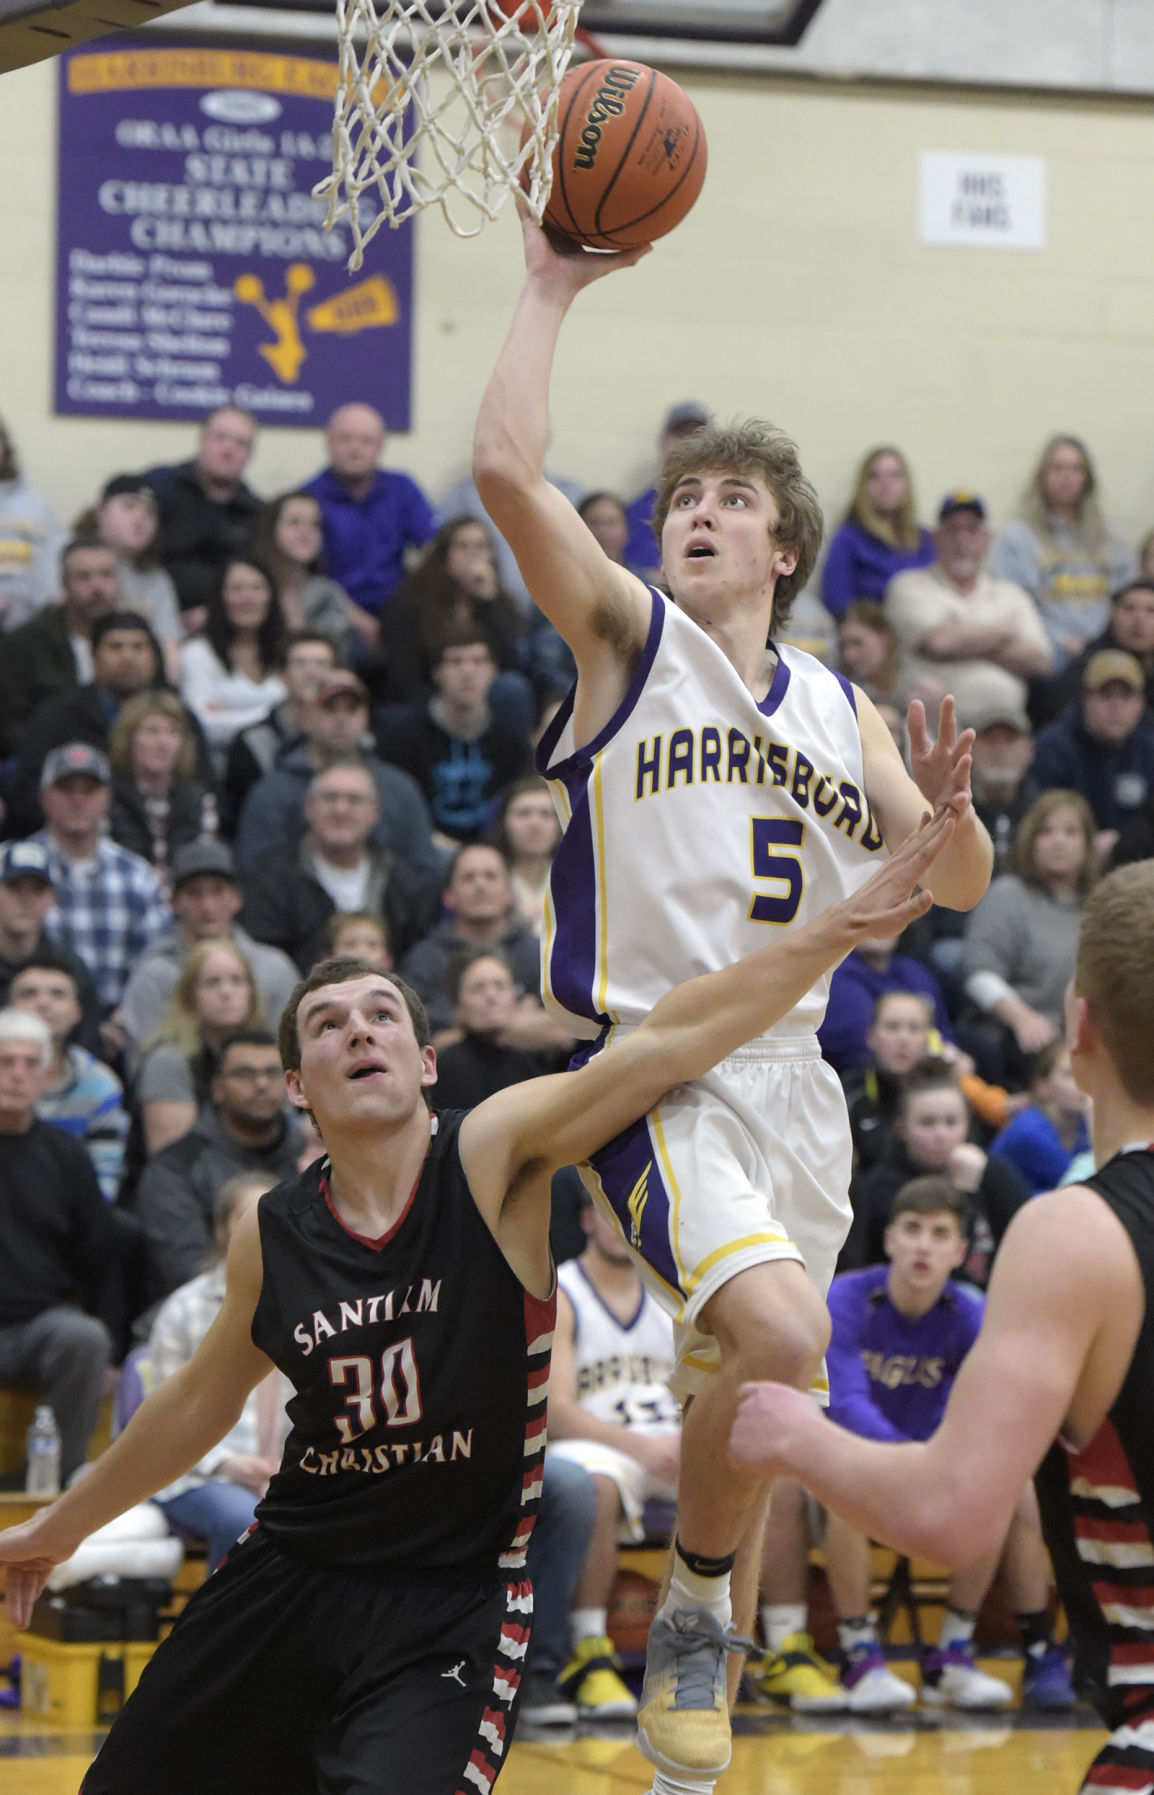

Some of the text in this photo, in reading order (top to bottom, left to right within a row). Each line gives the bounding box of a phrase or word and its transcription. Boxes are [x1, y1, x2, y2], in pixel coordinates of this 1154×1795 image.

[572, 65, 642, 172] Wilson
[748, 815, 806, 926] 5
[328, 1335, 424, 1445] 30
[299, 1427, 474, 1476] CHRISTIAN
